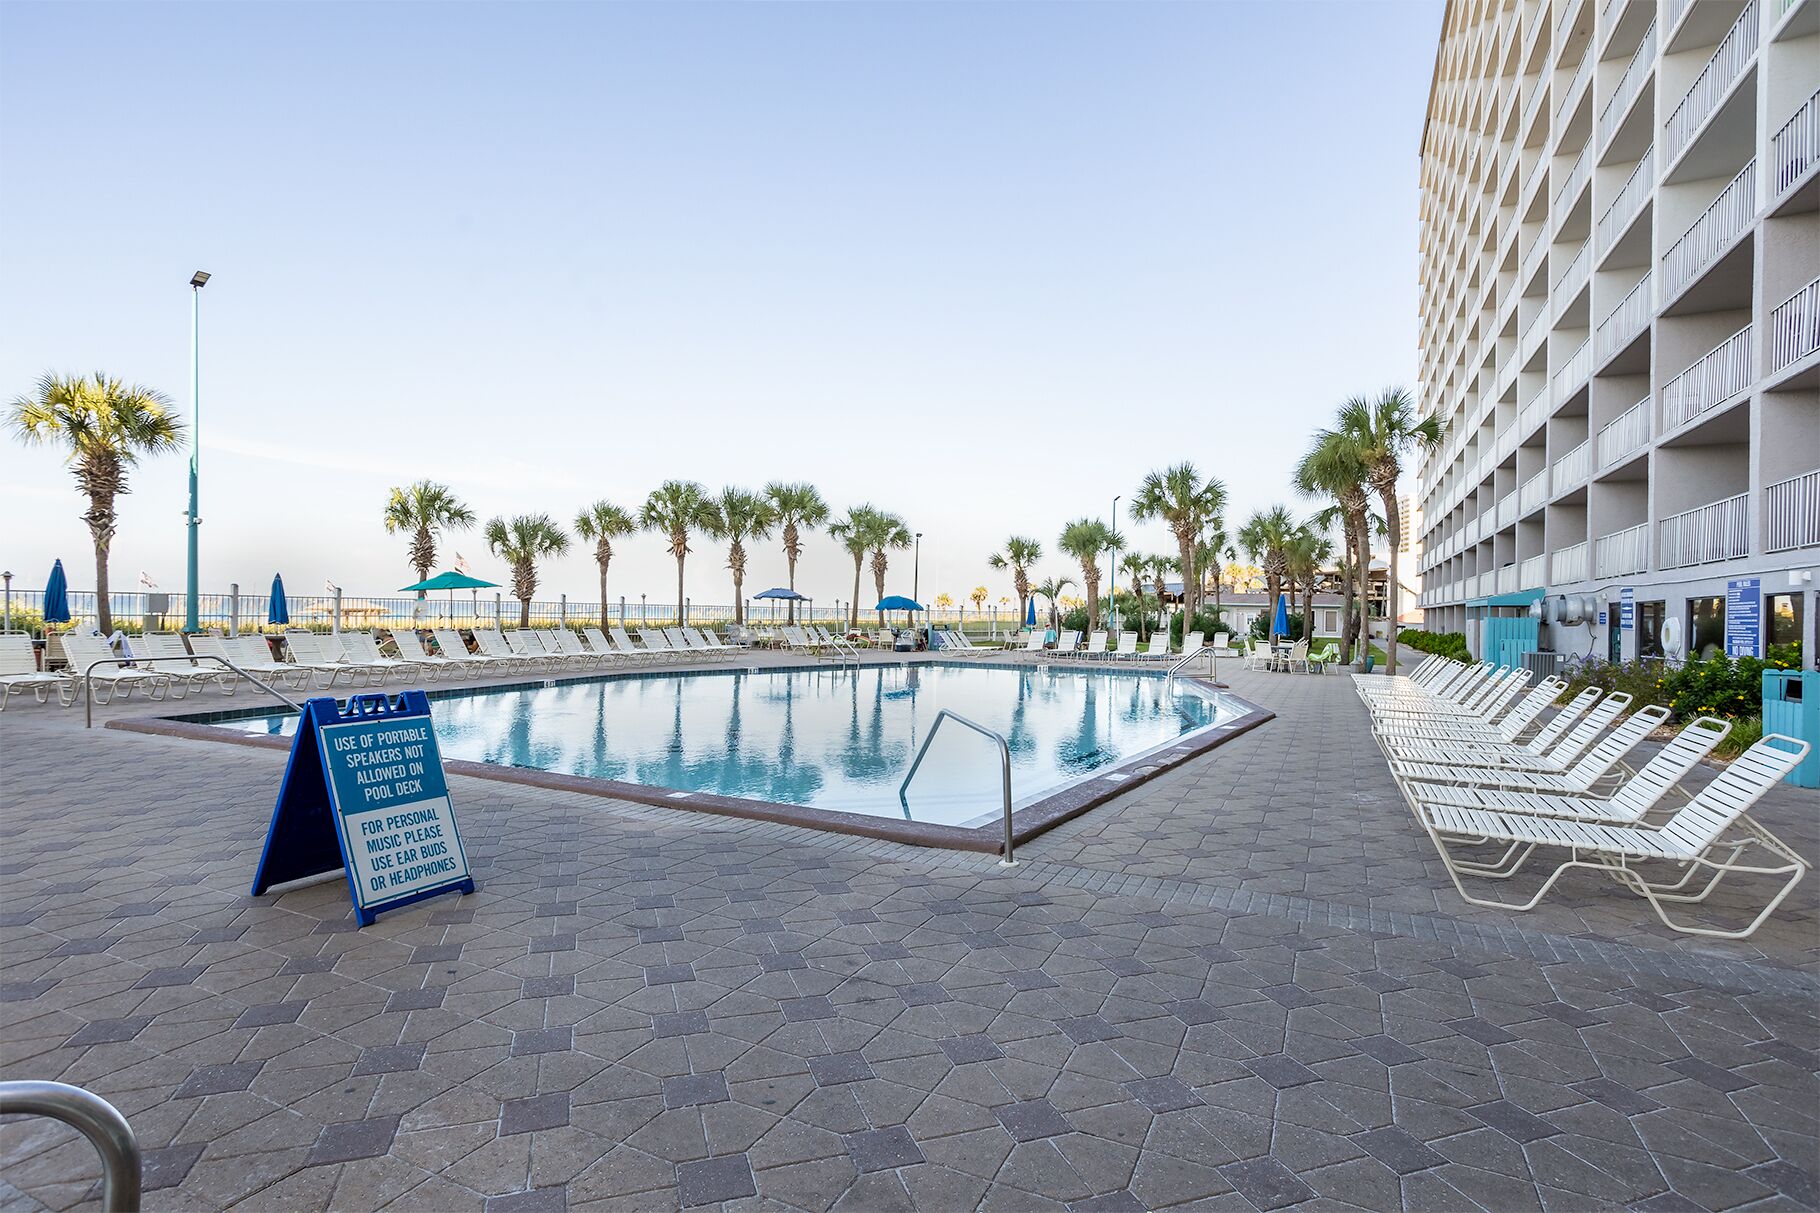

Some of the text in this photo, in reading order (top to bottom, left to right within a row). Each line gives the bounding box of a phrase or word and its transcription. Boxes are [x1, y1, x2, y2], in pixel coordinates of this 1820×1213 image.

[334, 727, 428, 751] USE OF PORTABLE
[346, 744, 424, 768] SPEAKERS NOT
[357, 762, 424, 784] ALLOWED ON
[364, 779, 423, 801] POOL DECK
[361, 808, 439, 836] FOR PERSONAL
[366, 825, 443, 853] MUSIC PLEASE
[371, 841, 447, 871] USE EAR BUDS
[370, 857, 456, 891] OR HEADPHONES
